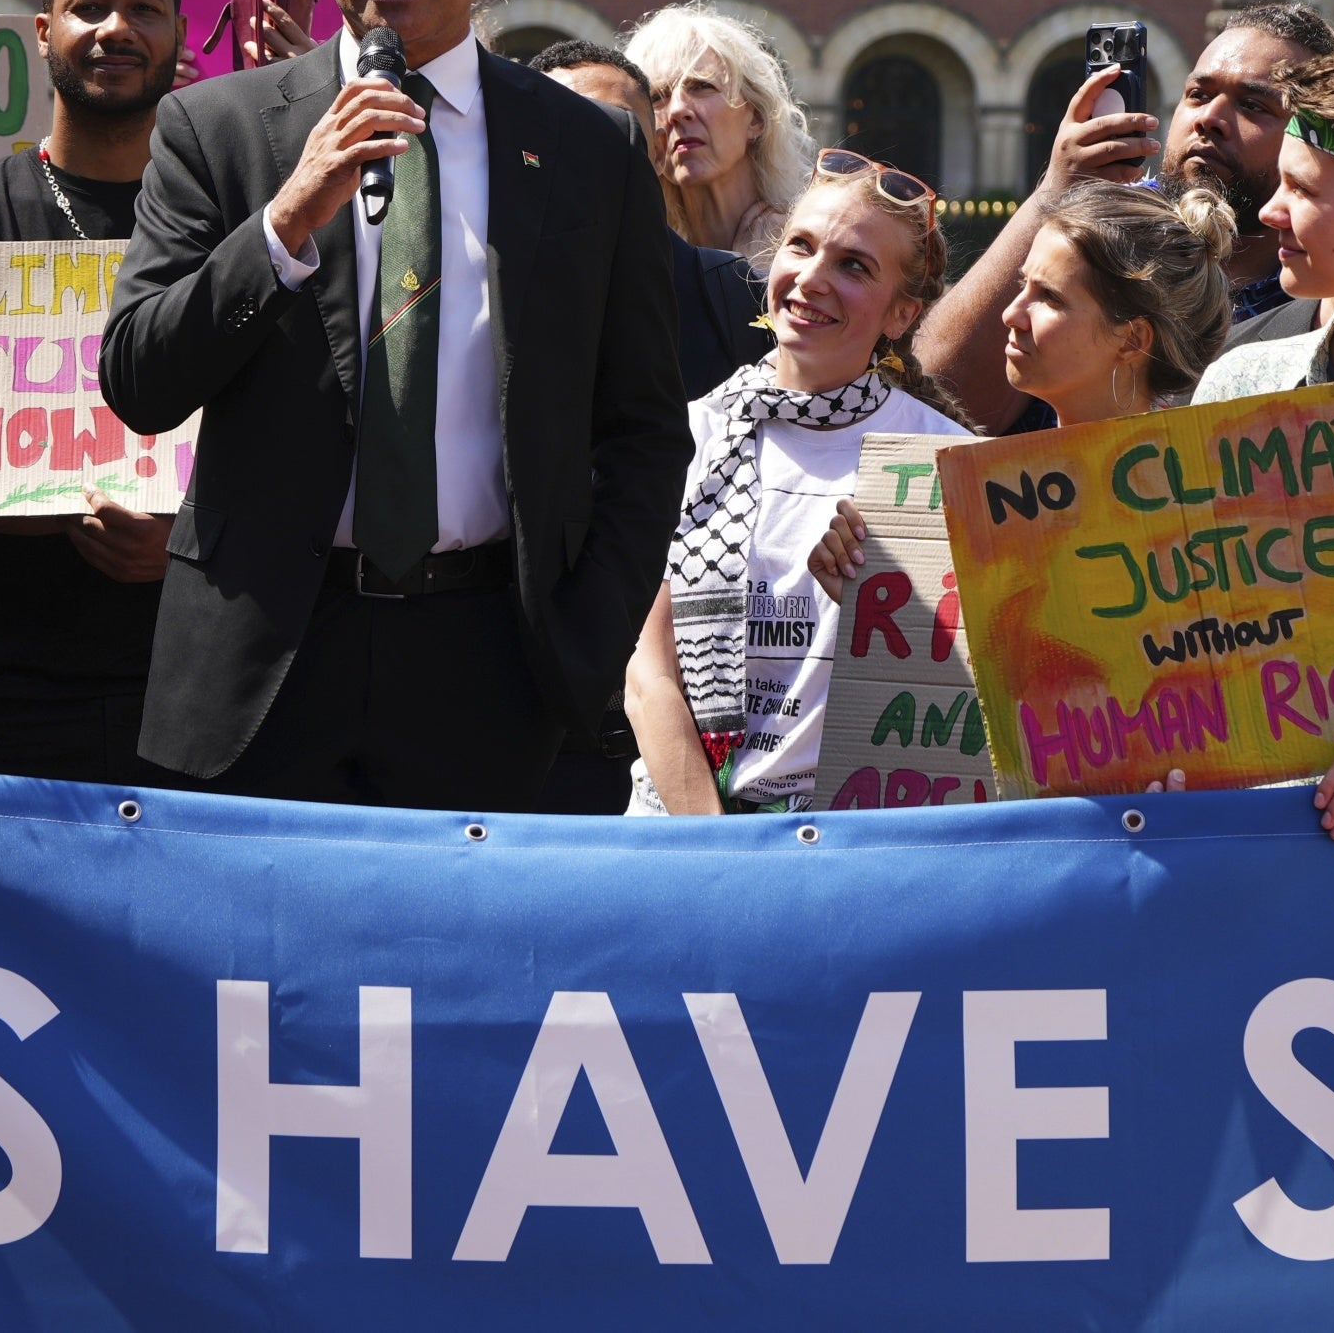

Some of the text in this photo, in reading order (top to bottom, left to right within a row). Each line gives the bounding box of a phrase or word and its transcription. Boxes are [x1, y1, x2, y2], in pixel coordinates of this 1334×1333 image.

[985, 469, 1077, 526] NO
[746, 620, 816, 648] TIMIST
[1019, 679, 1229, 786] HUMAN
[216, 979, 1110, 1265] HAVE
